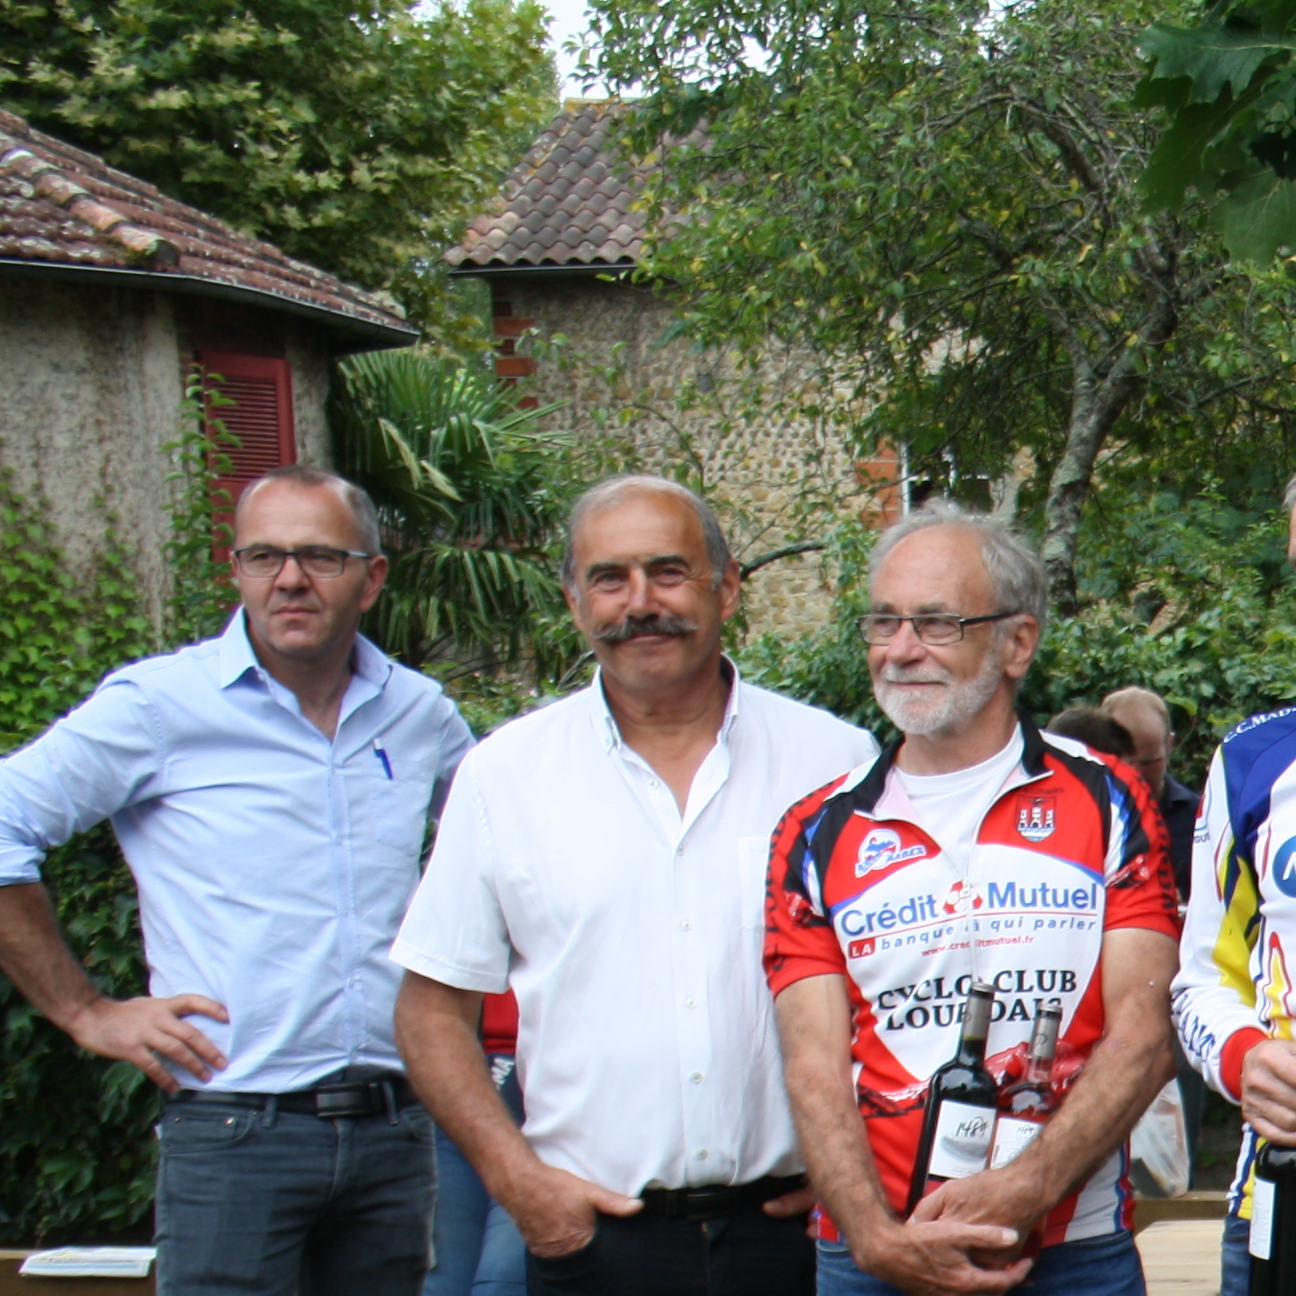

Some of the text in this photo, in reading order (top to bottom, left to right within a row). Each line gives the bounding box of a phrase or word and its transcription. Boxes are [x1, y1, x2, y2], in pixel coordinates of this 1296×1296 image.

[840, 881, 1098, 937] Crédit Mutuel
[851, 943, 873, 957] LA
[880, 925, 955, 951] banque
[991, 917, 1023, 933] qui
[1033, 916, 1097, 933] parler
[877, 969, 1077, 1011] CYCLO CLUB
